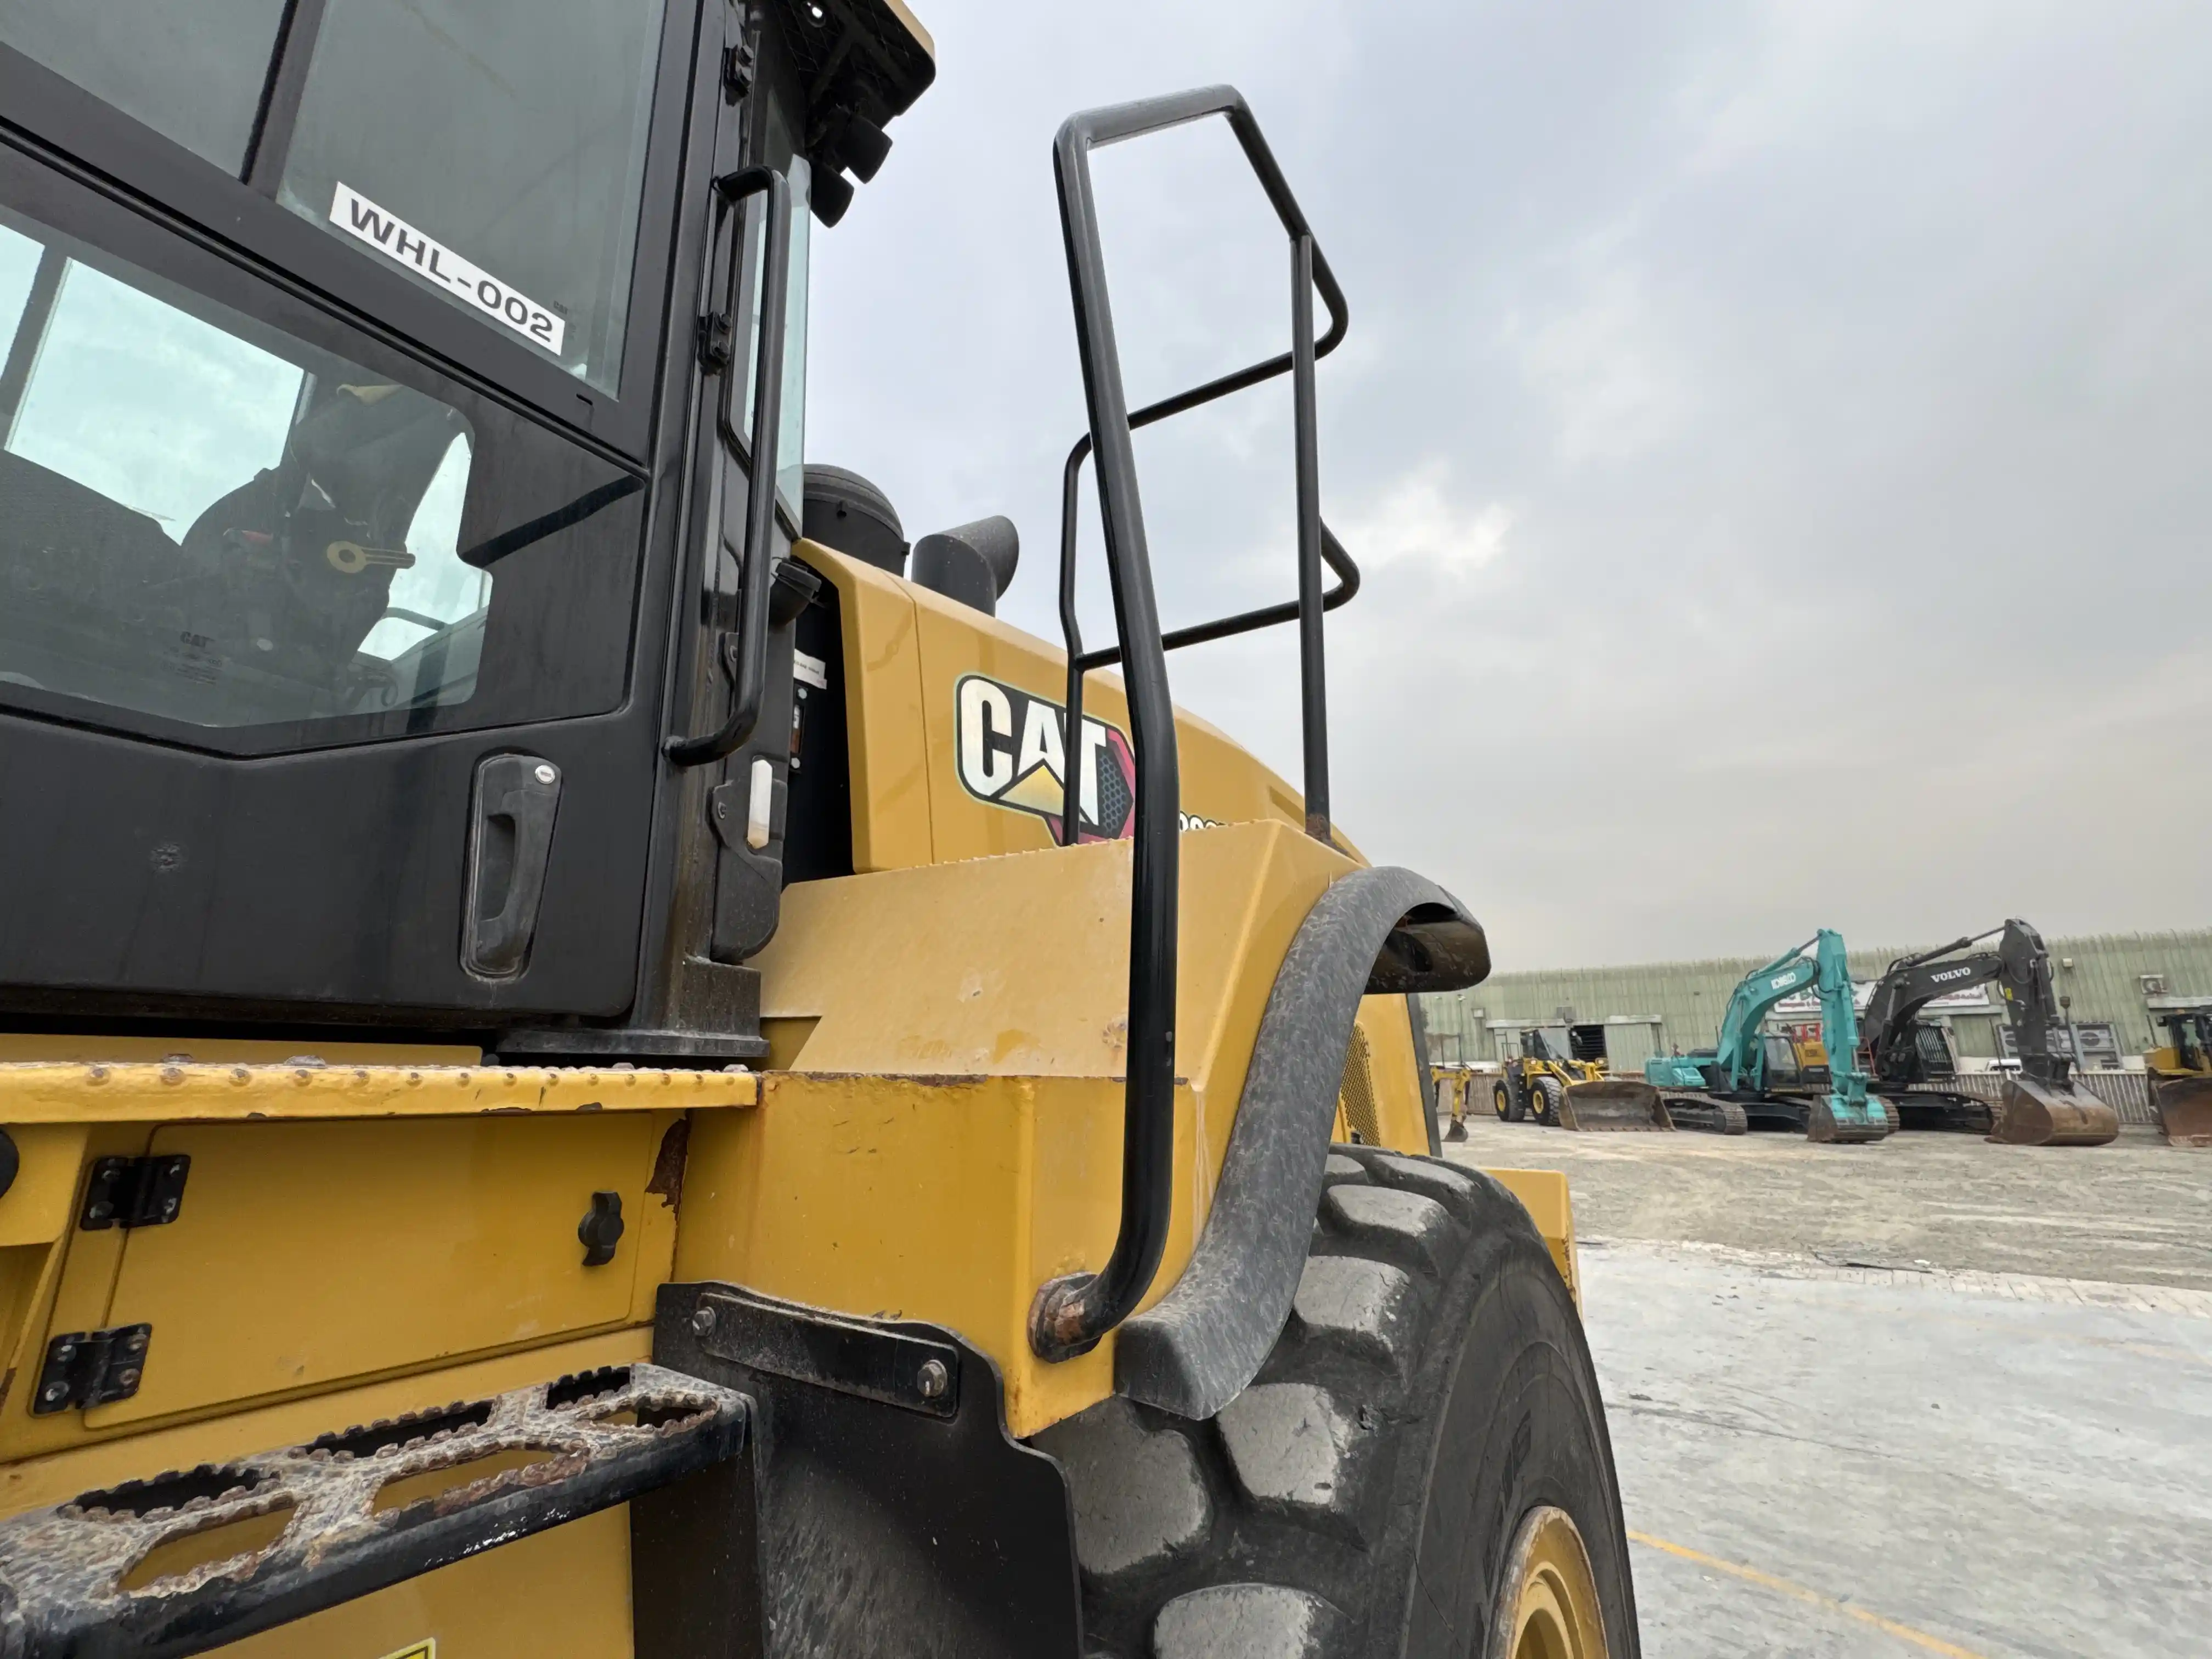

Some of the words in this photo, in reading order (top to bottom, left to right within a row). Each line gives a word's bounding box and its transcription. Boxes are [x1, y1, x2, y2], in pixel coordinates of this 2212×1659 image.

[351, 198, 553, 342] WHL-002
[961, 679, 1106, 826] CAT
[1931, 967, 1971, 983] VOLVO
